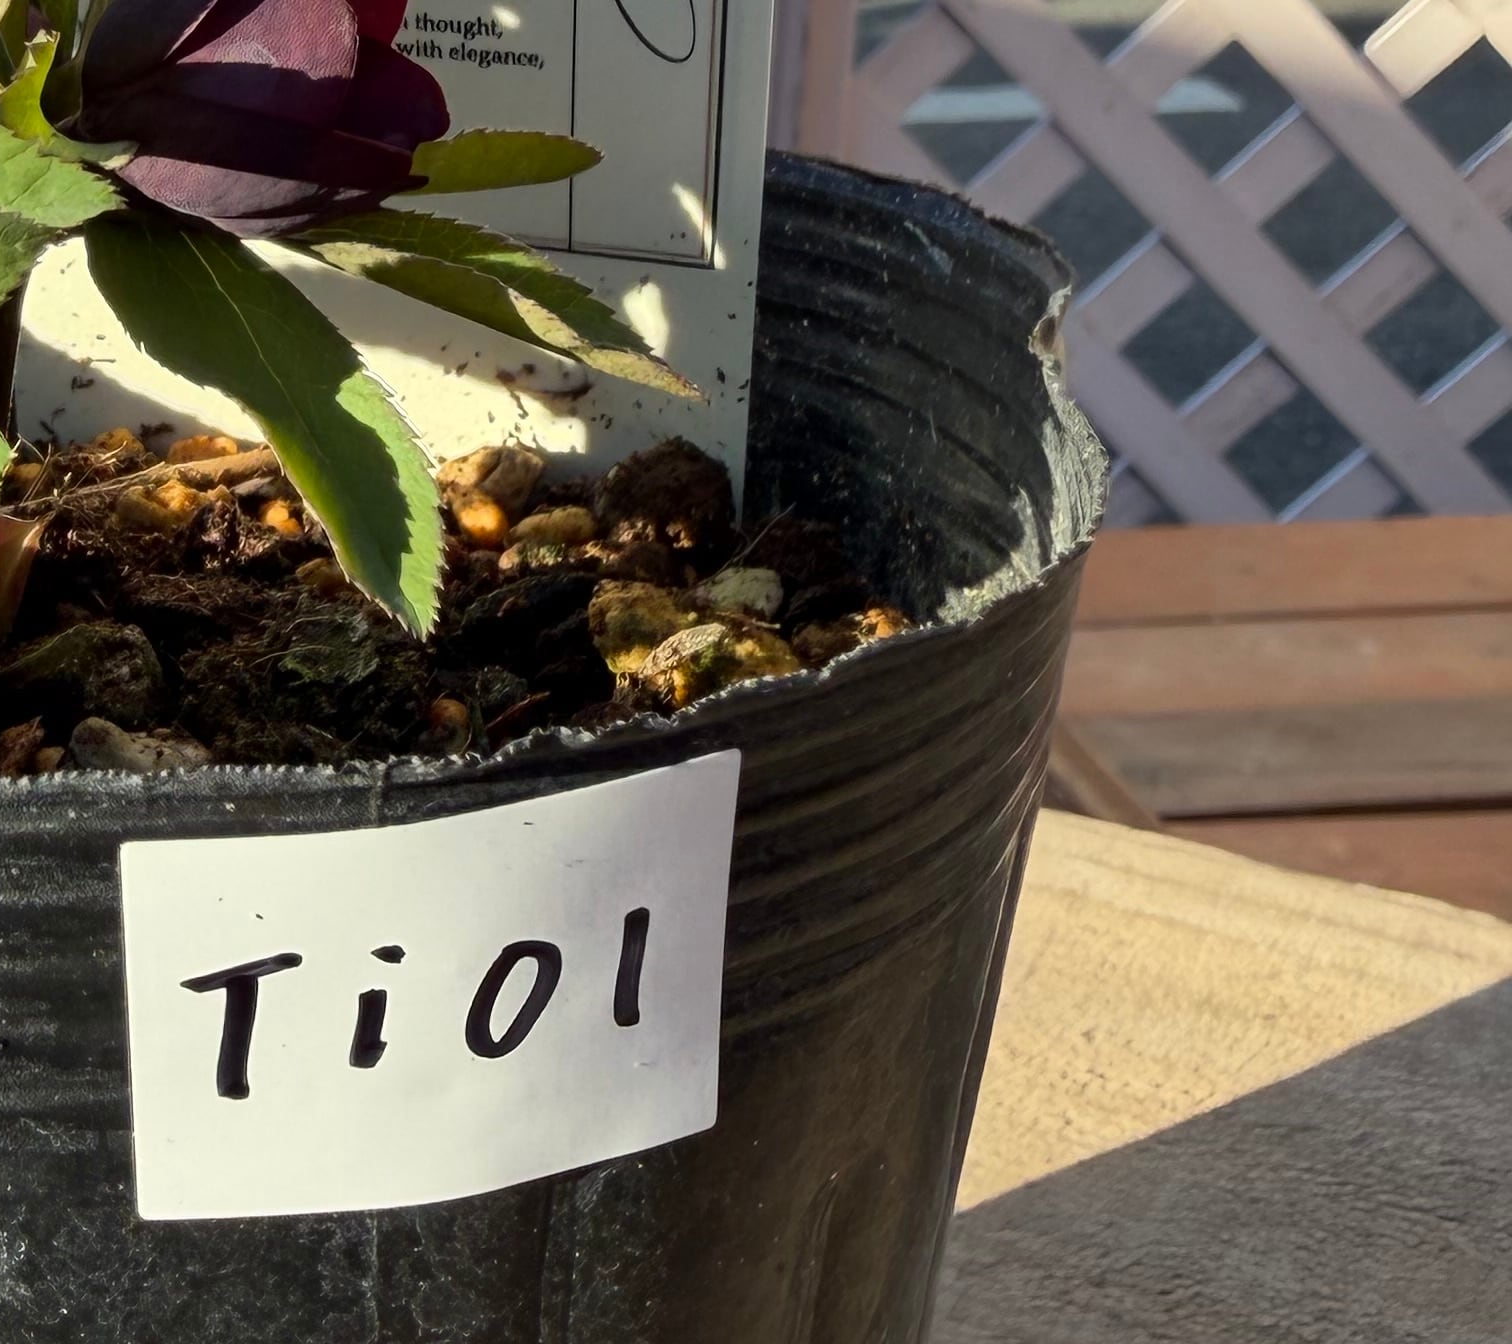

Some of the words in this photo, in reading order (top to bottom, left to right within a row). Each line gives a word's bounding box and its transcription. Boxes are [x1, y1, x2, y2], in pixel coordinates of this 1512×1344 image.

[415, 12, 504, 40] thought,
[395, 39, 444, 60] with
[449, 43, 545, 70] elegance,
